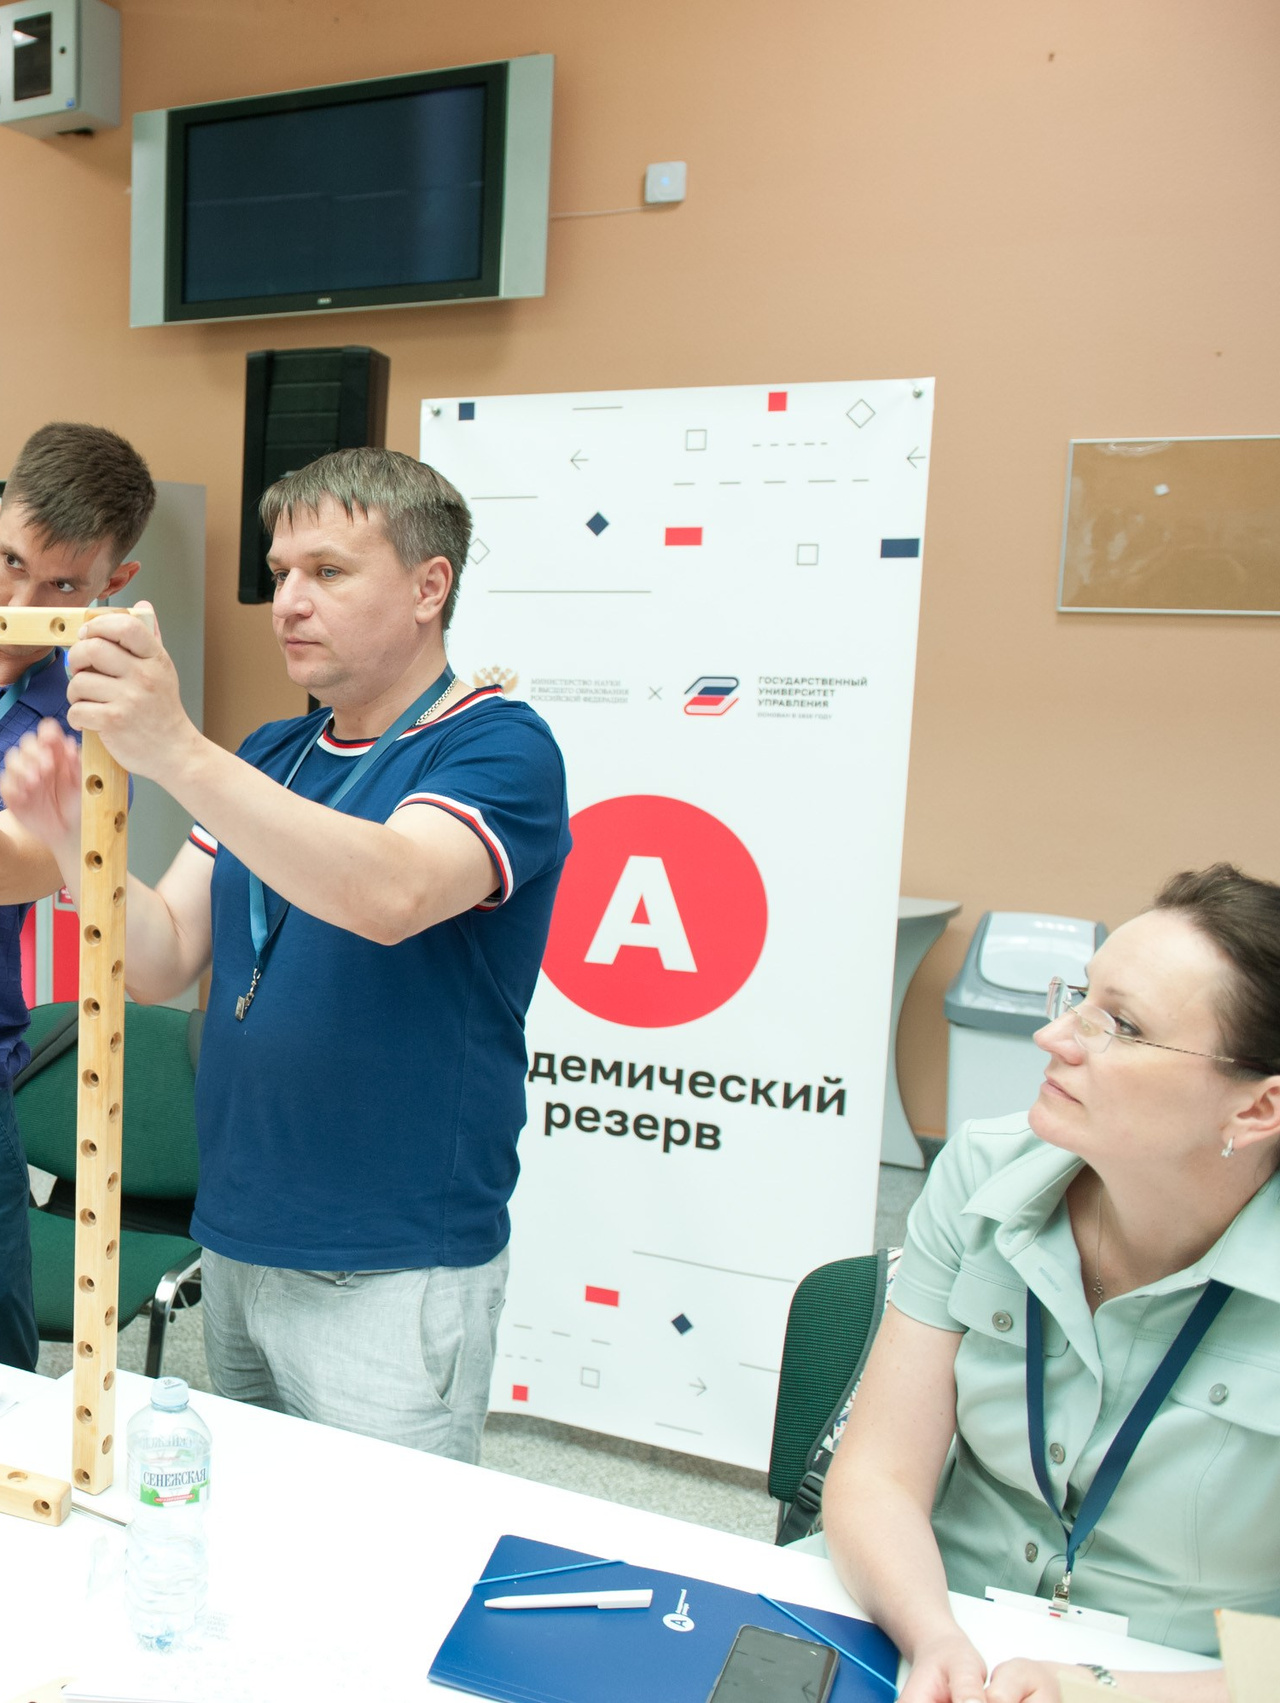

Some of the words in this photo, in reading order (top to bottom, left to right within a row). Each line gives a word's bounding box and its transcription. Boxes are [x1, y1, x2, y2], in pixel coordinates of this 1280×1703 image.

[530, 678, 592, 686] МИНИСТЕРСТВО
[594, 679, 622, 687] НАУКИ
[758, 676, 868, 687] ГОСУДАРСТВЕННЫЙ
[758, 688, 836, 697] УНИВЕРСИТЕТ
[757, 699, 829, 708] УПРАВЛЕНИЯ
[528, 1051, 847, 1116] демический
[544, 1100, 722, 1153] резерв
[143, 1468, 206, 1488] СЕНЕЖСКАЯ
